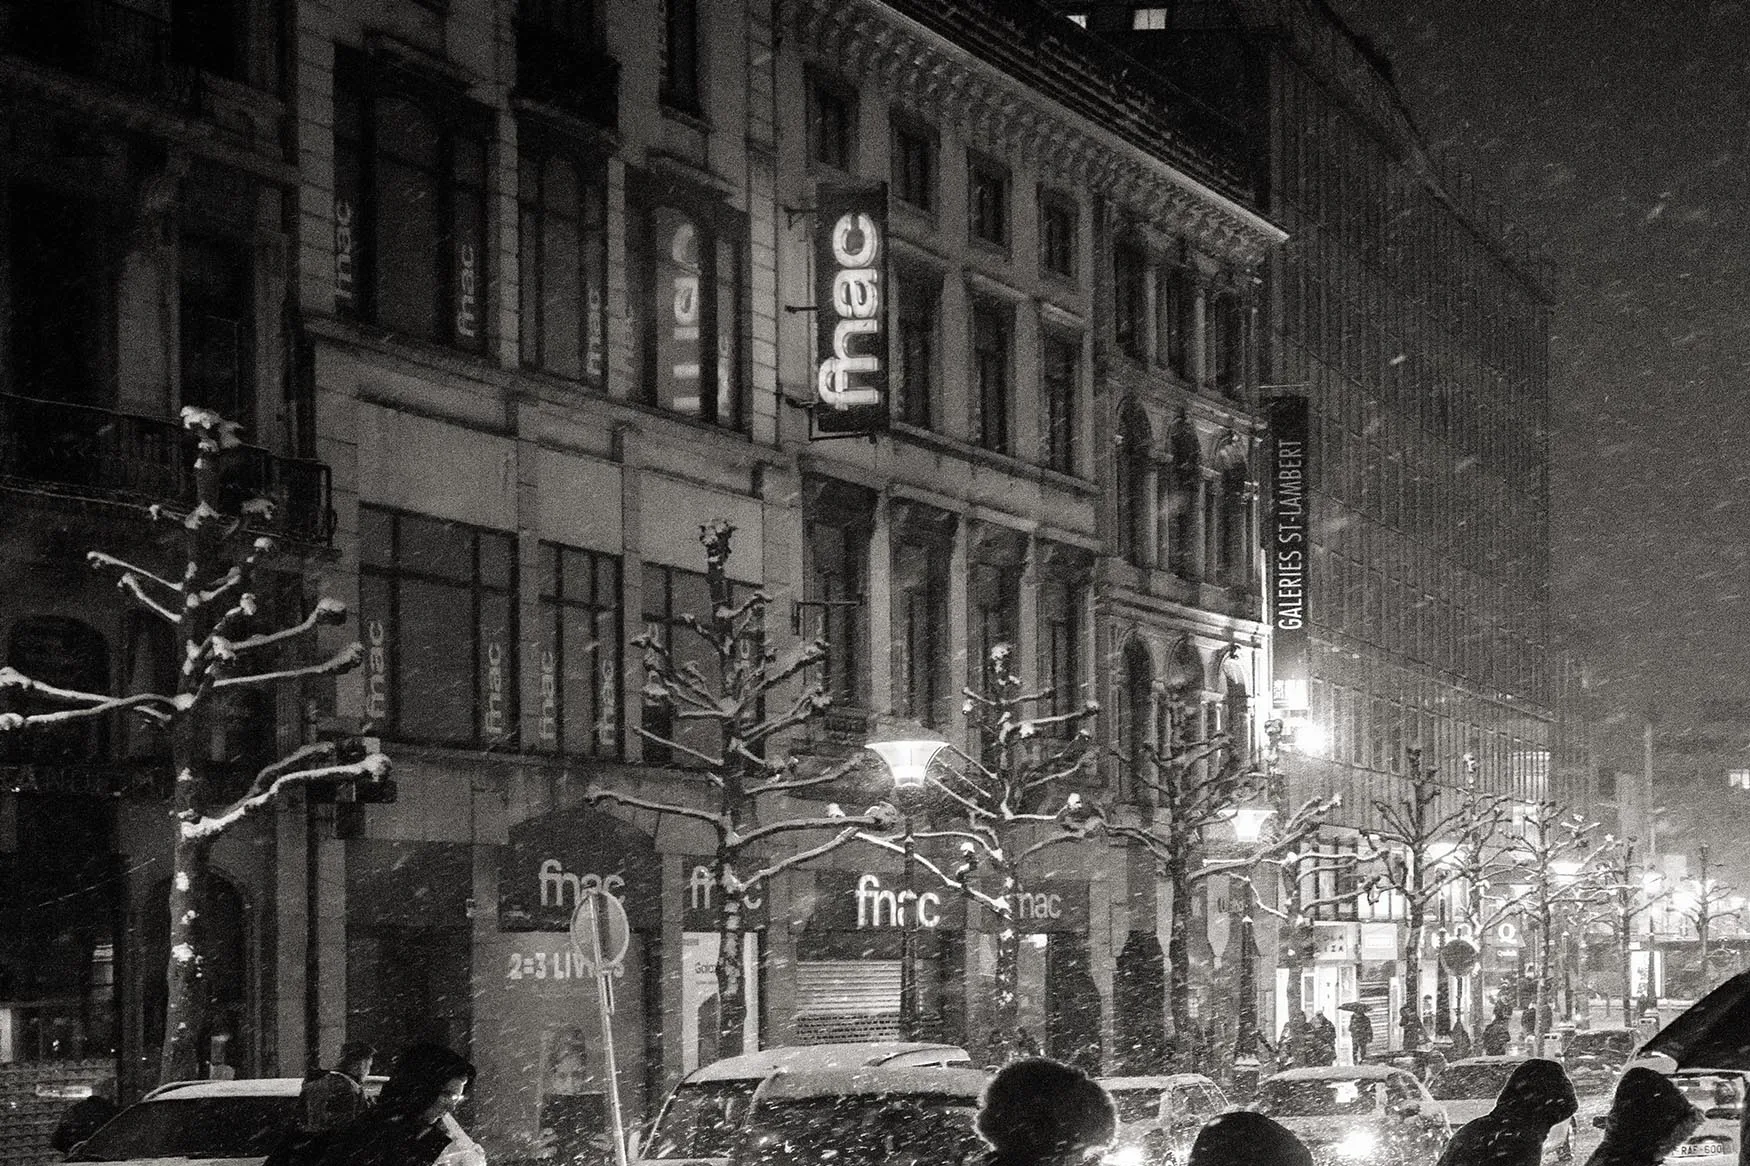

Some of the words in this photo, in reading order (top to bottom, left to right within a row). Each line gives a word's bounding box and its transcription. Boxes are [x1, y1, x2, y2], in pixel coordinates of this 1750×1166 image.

[818, 212, 880, 410] fnac
[1278, 439, 1303, 544] ST-LAMBERT
[1278, 551, 1303, 630] GALERIES
